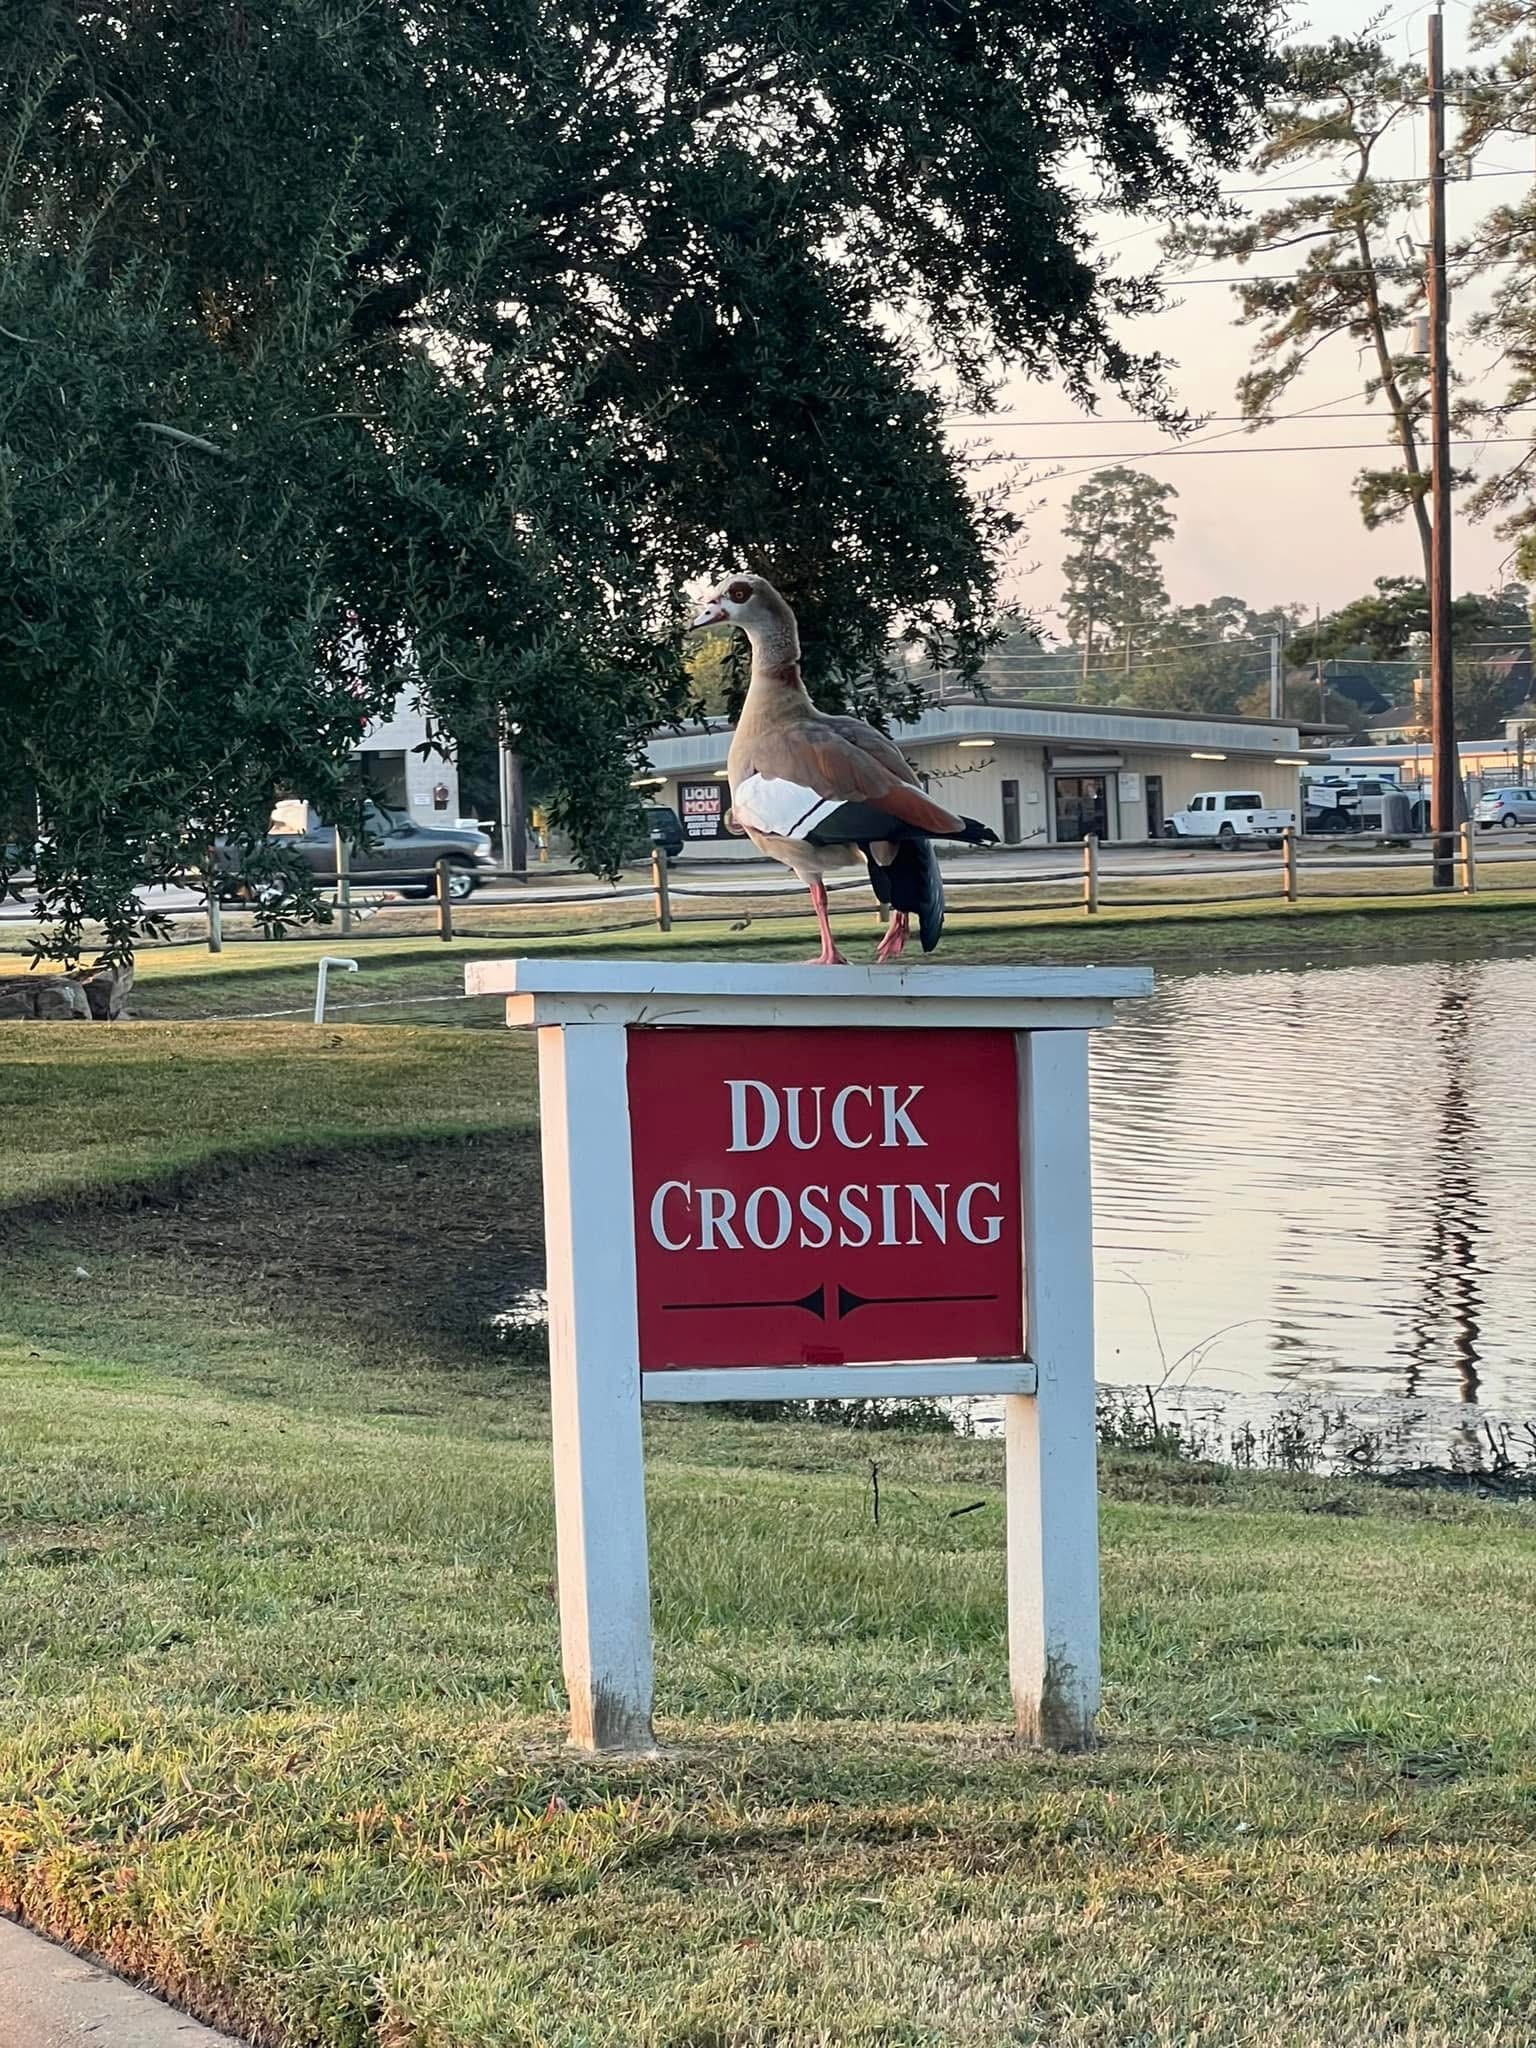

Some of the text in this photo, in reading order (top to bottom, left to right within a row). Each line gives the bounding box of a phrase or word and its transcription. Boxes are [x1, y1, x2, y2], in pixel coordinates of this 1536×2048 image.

[685, 788, 718, 800] LIQUI
[685, 801, 720, 813] MOLY
[724, 1080, 928, 1152] DUCK
[650, 1180, 1004, 1251] CROSSING
